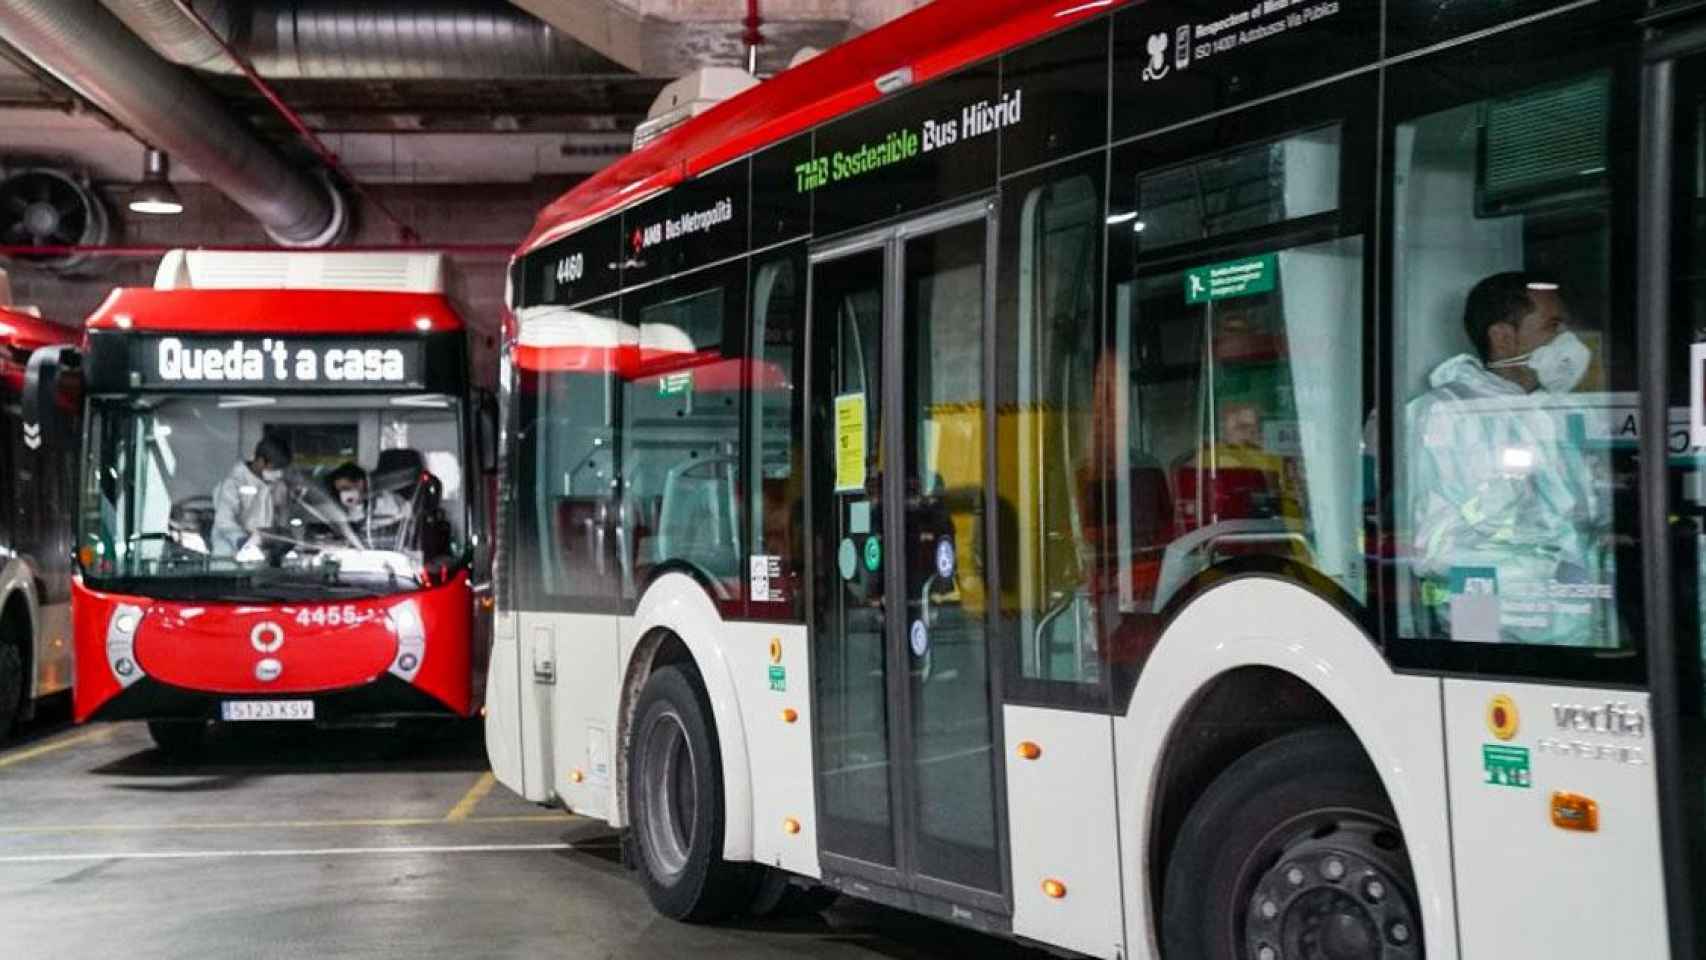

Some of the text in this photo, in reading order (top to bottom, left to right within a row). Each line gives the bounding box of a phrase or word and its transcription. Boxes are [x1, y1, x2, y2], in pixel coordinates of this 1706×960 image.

[795, 157, 829, 192] TMB
[832, 129, 919, 180] Sostenible
[922, 119, 957, 151] Bus
[642, 223, 662, 248] AMB
[665, 219, 681, 240] Bus
[556, 252, 583, 284] 4460
[158, 337, 404, 380] Queda't a casa
[296, 606, 356, 626] 4455
